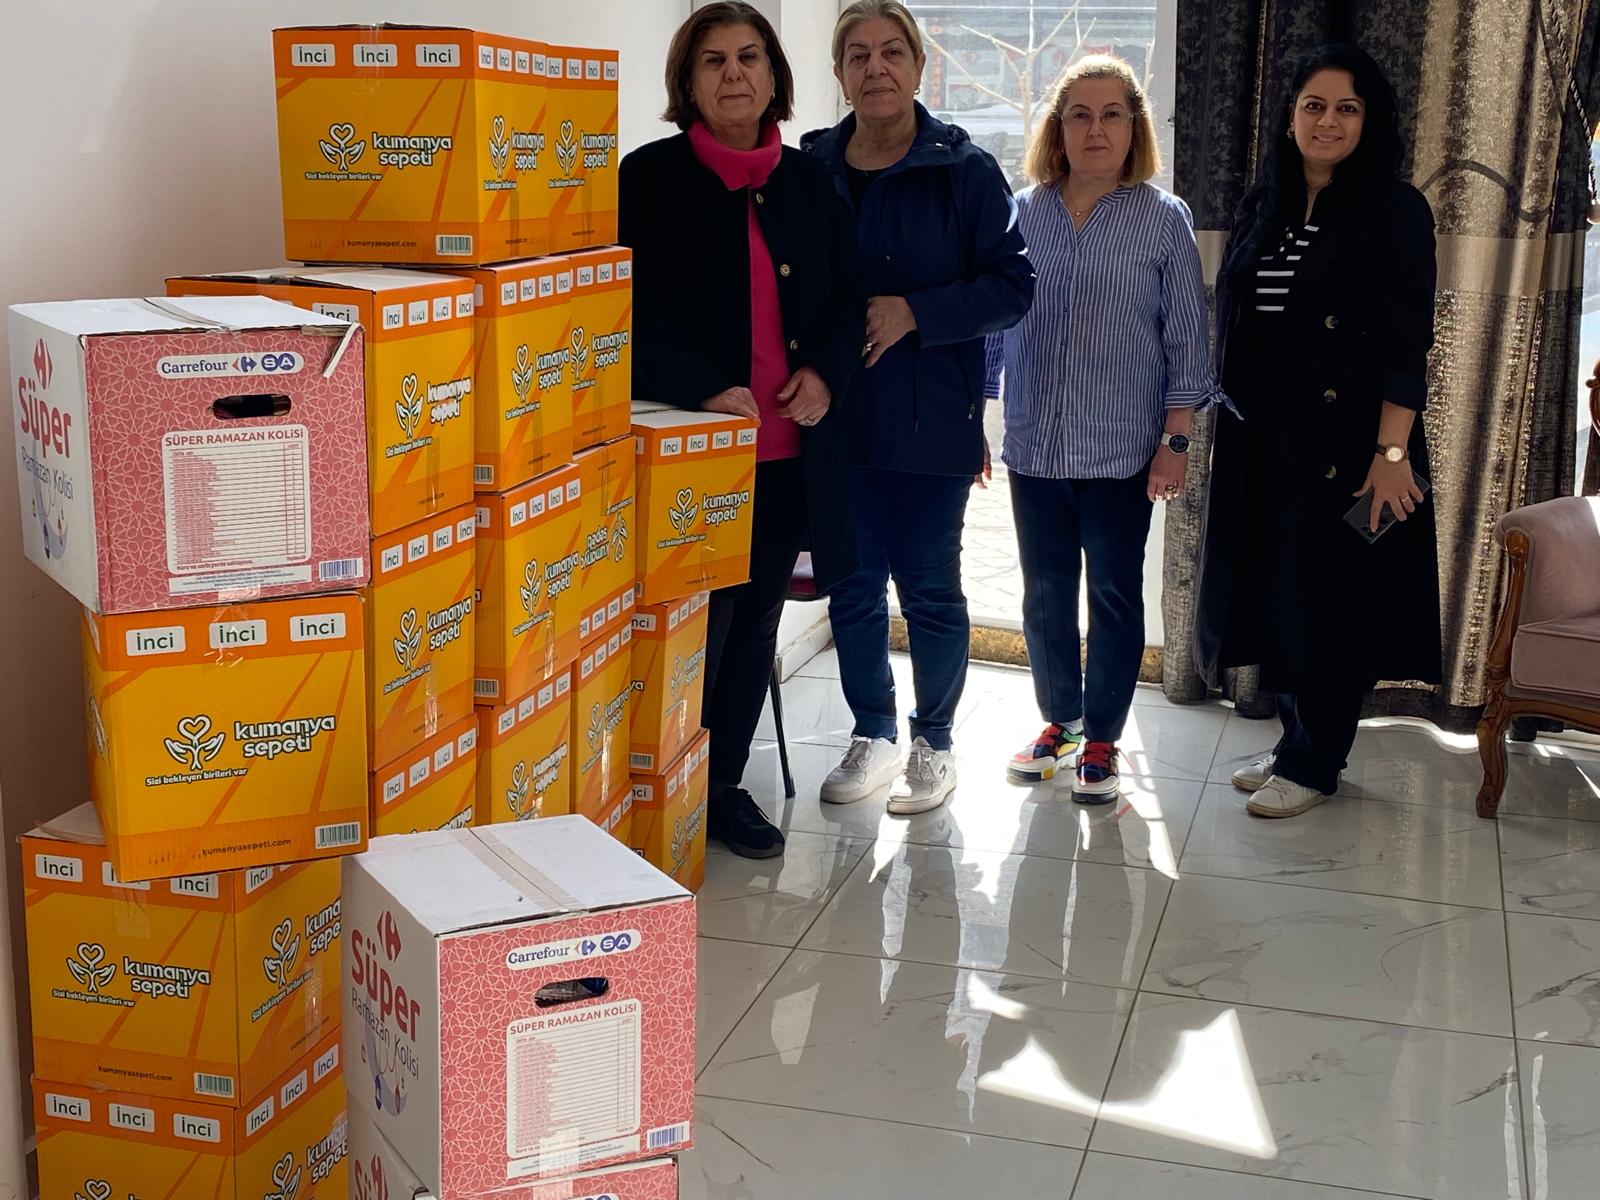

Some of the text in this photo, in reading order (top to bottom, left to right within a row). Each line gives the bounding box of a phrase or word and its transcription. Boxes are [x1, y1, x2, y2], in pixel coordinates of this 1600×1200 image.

[299, 46, 452, 63] İnci İnci İnci
[372, 132, 452, 154] kumanya
[511, 128, 545, 154] kumanya
[580, 130, 616, 153] kumanya
[380, 151, 432, 169] sepeti
[592, 332, 629, 352] kumanya
[161, 353, 295, 374] Carrefour SA
[18, 376, 72, 459] Süper
[165, 434, 204, 447] SÜPER
[206, 430, 265, 445] RAMAZAN
[702, 491, 750, 512] kumanya
[705, 507, 738, 528] sepeti
[545, 551, 580, 582] kumanya
[426, 597, 472, 633] kumanya
[631, 617, 650, 628] nci
[136, 619, 336, 650] İnci İnci İnci
[430, 622, 461, 651] sepeti
[234, 716, 336, 742] kumanya
[243, 733, 312, 760] sepeti
[146, 776, 161, 787] Sizi
[162, 772, 203, 784] bekleyen
[233, 767, 248, 778] var
[202, 837, 292, 856] kumanyasepeti.com
[43, 857, 75, 877] İnci
[508, 933, 631, 965] Carrefour SA
[123, 956, 212, 986] kumanya
[131, 979, 190, 999] sepeti
[351, 928, 420, 1042] Süper
[352, 987, 419, 1080] Ramazan Kolisi
[510, 1021, 545, 1036] SÜPER
[547, 1009, 602, 1028] RAMAZAN
[54, 1096, 212, 1138] İnci İnci İnci
[251, 1107, 270, 1130] İnci
[285, 1081, 303, 1104] İnci
